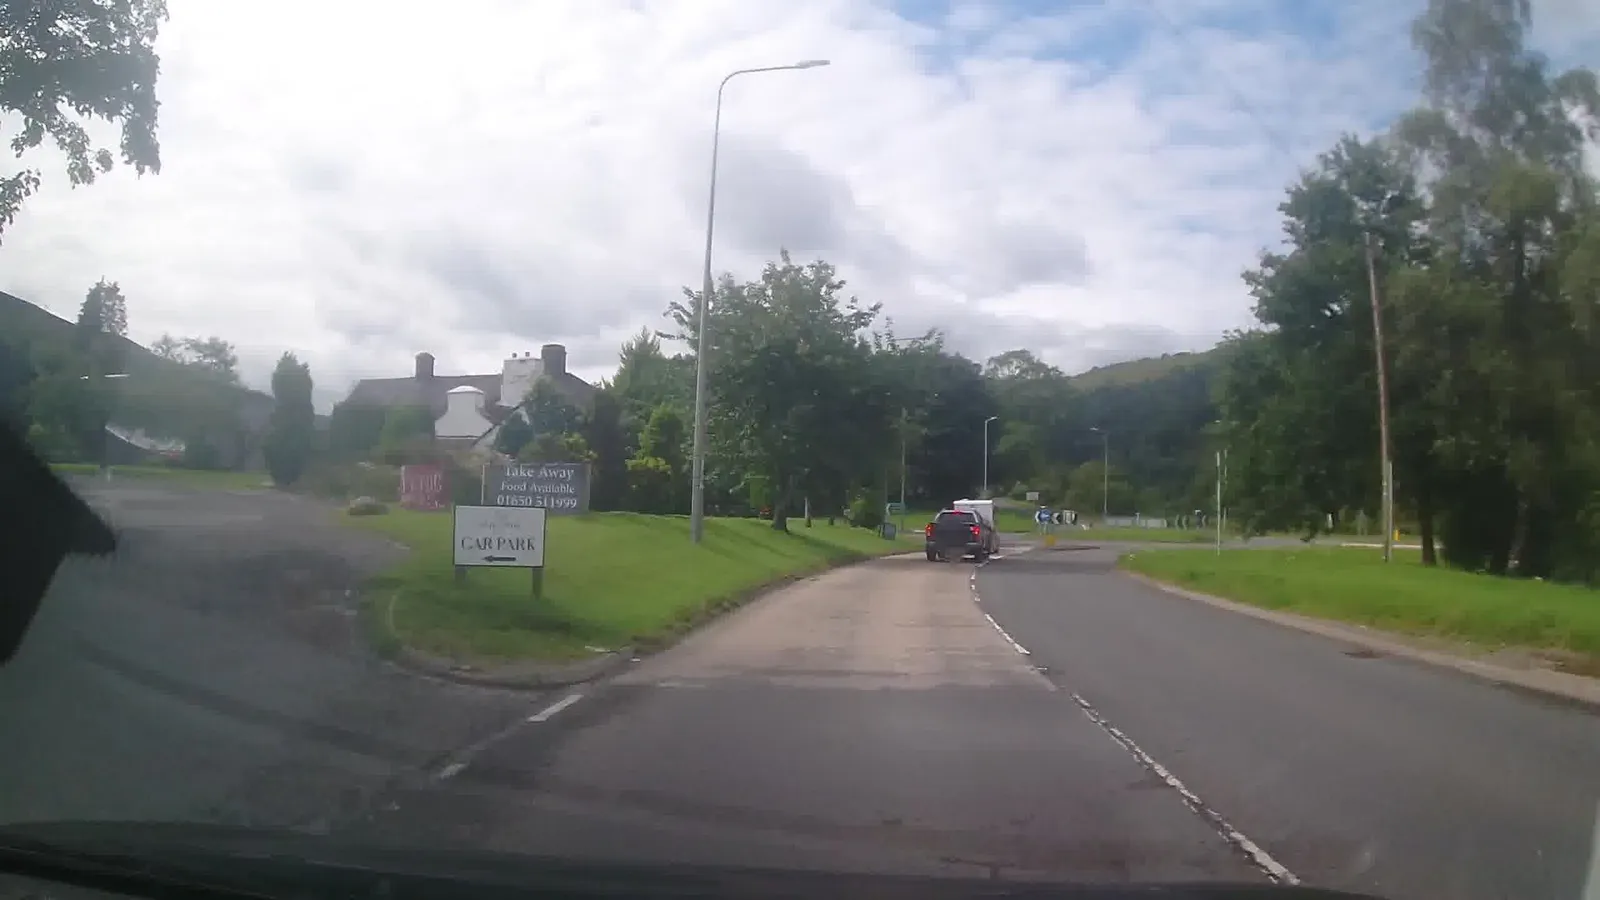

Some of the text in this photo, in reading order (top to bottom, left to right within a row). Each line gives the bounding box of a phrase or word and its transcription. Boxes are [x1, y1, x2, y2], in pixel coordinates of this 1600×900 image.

[505, 465, 575, 481] Take Away
[500, 481, 576, 494] Food Available
[535, 497, 577, 509] 511999
[461, 537, 536, 551] CAR PARK
